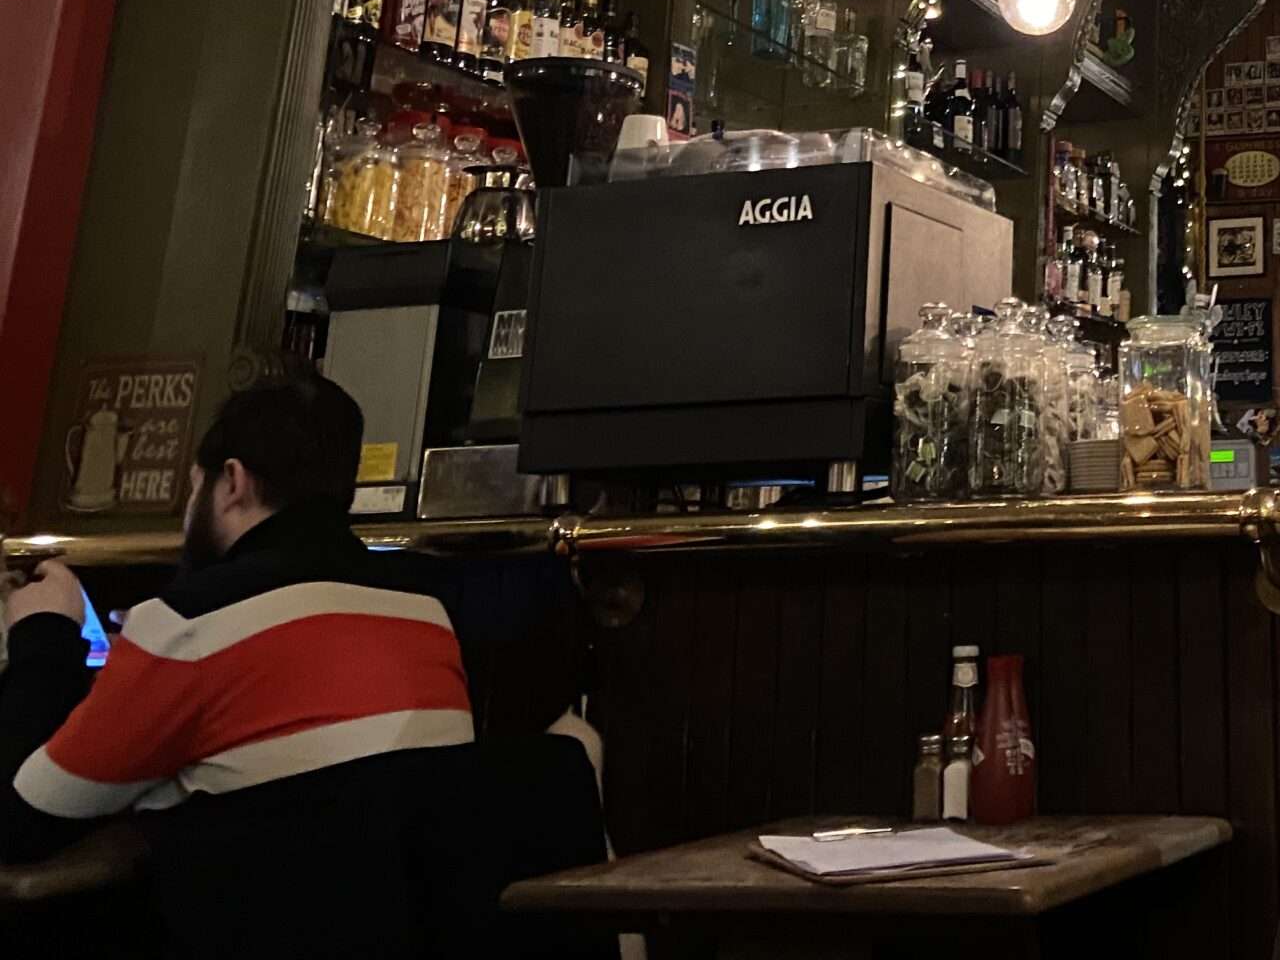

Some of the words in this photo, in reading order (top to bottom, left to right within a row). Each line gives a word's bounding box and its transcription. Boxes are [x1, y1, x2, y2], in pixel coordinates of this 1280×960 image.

[738, 194, 814, 226] AGGIA
[88, 376, 112, 400] The
[114, 372, 195, 409] PERKS
[132, 434, 179, 461] best
[120, 469, 175, 501] HERE
